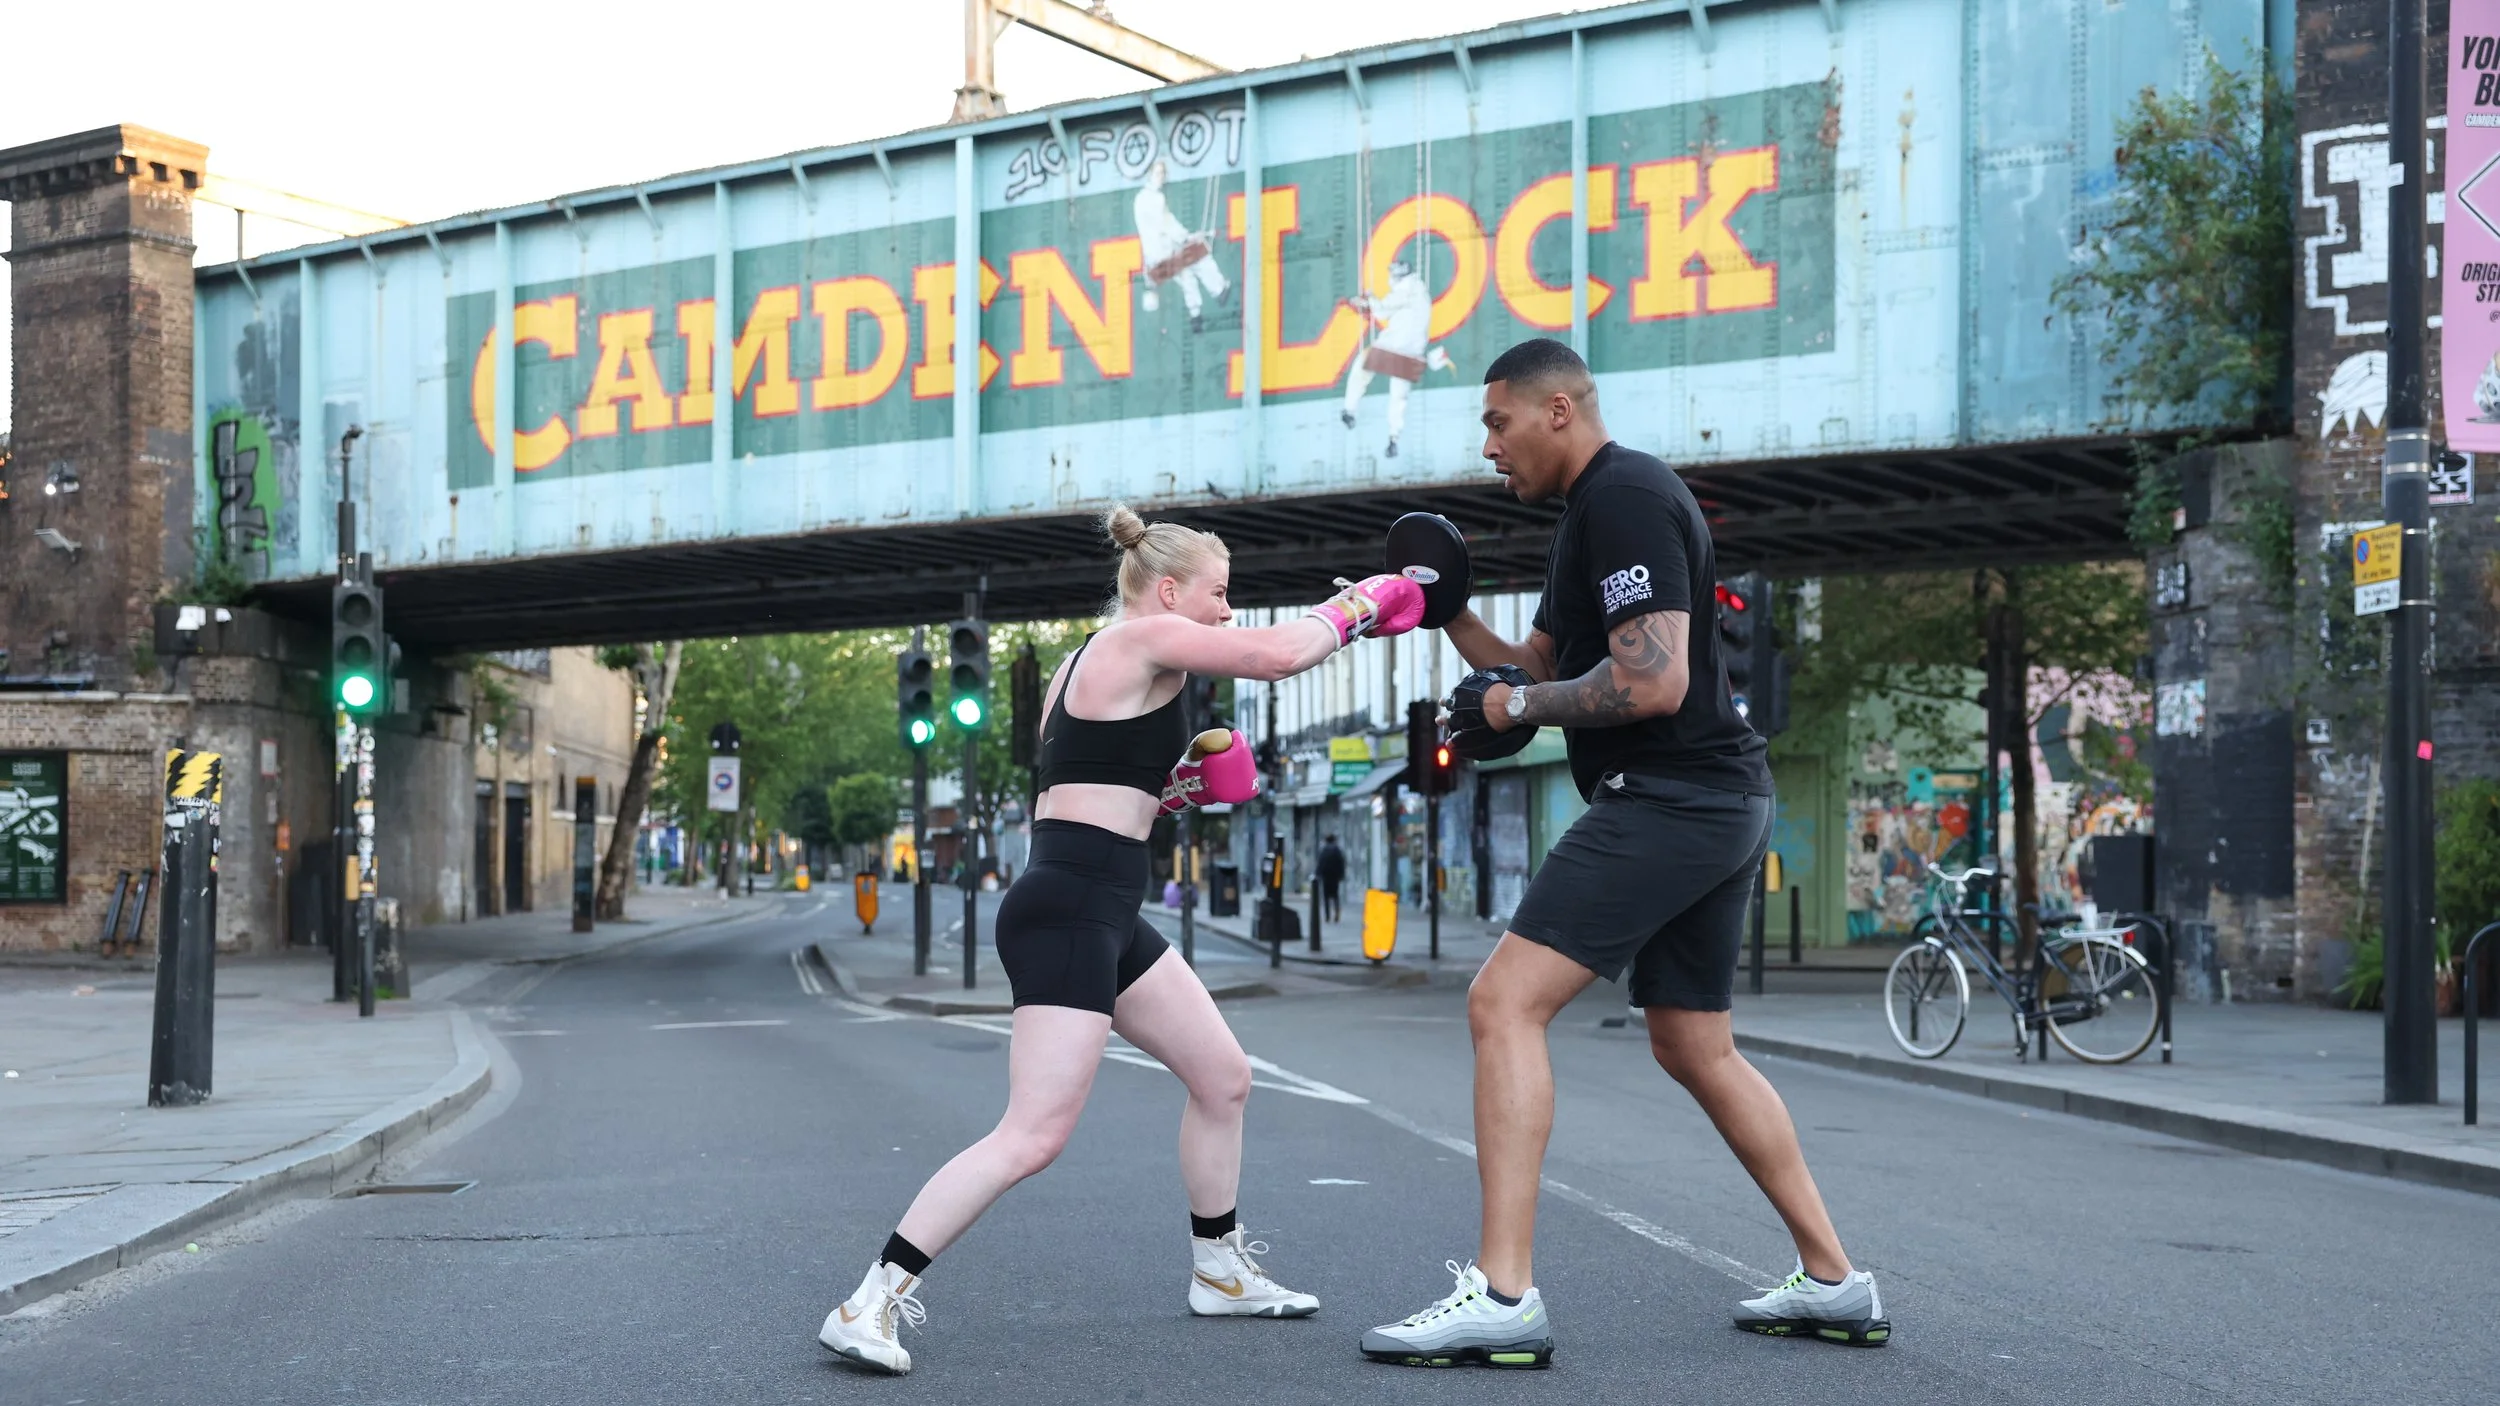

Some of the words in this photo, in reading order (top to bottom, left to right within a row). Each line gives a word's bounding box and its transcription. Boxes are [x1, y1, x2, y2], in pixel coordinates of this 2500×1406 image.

[472, 235, 1143, 473] CAMDEN
[1226, 143, 1779, 398] LOCK
[1600, 565, 1649, 599] ZERO
[1604, 582, 1652, 608] TOLERANCE
[1621, 591, 1653, 606] FACTORY
